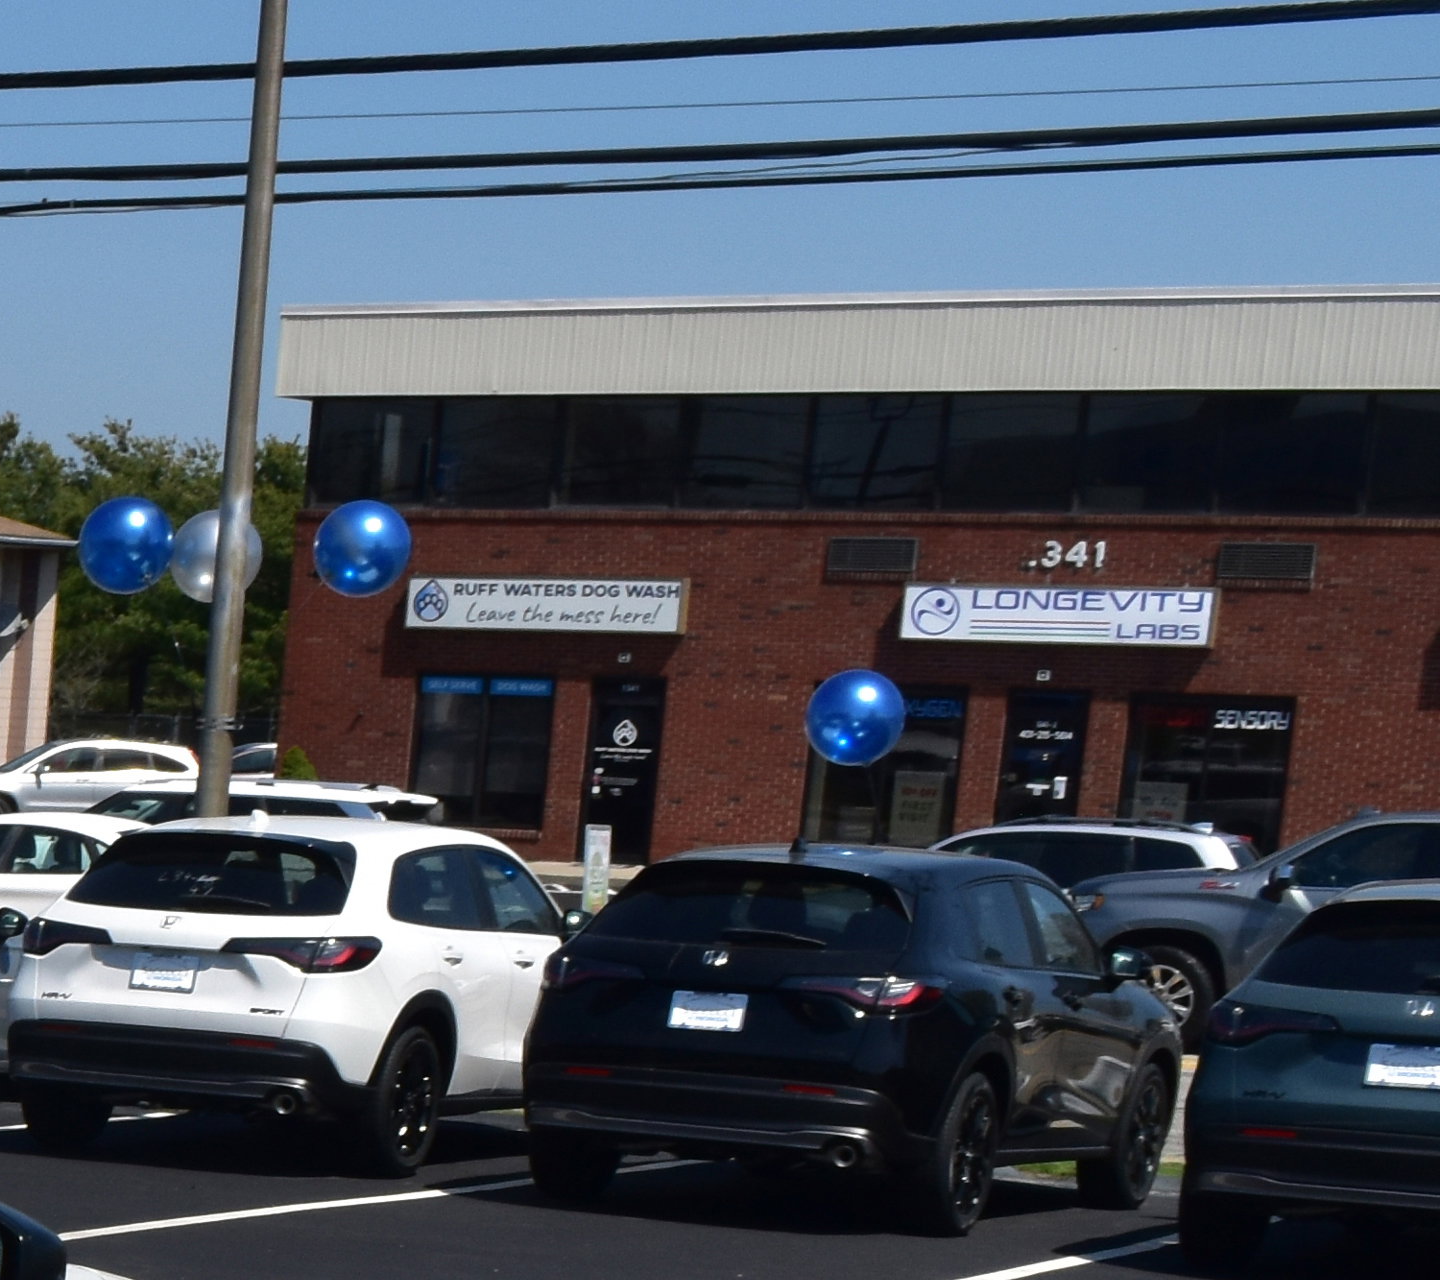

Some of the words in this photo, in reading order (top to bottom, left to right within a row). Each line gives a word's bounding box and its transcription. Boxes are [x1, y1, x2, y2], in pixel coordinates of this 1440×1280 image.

[453, 583, 498, 596] RUFF
[504, 583, 577, 597] WATERS
[581, 584, 620, 597] DOG
[626, 585, 680, 599] WASH
[971, 590, 1205, 613] LONGEVITY
[466, 602, 515, 624] Leave
[522, 604, 553, 623] the
[559, 608, 602, 624] mess
[609, 604, 663, 625] here!
[1116, 623, 1201, 640] LABS
[1213, 709, 1290, 731] SENSORY
[249, 1007, 285, 1016] SPORT
